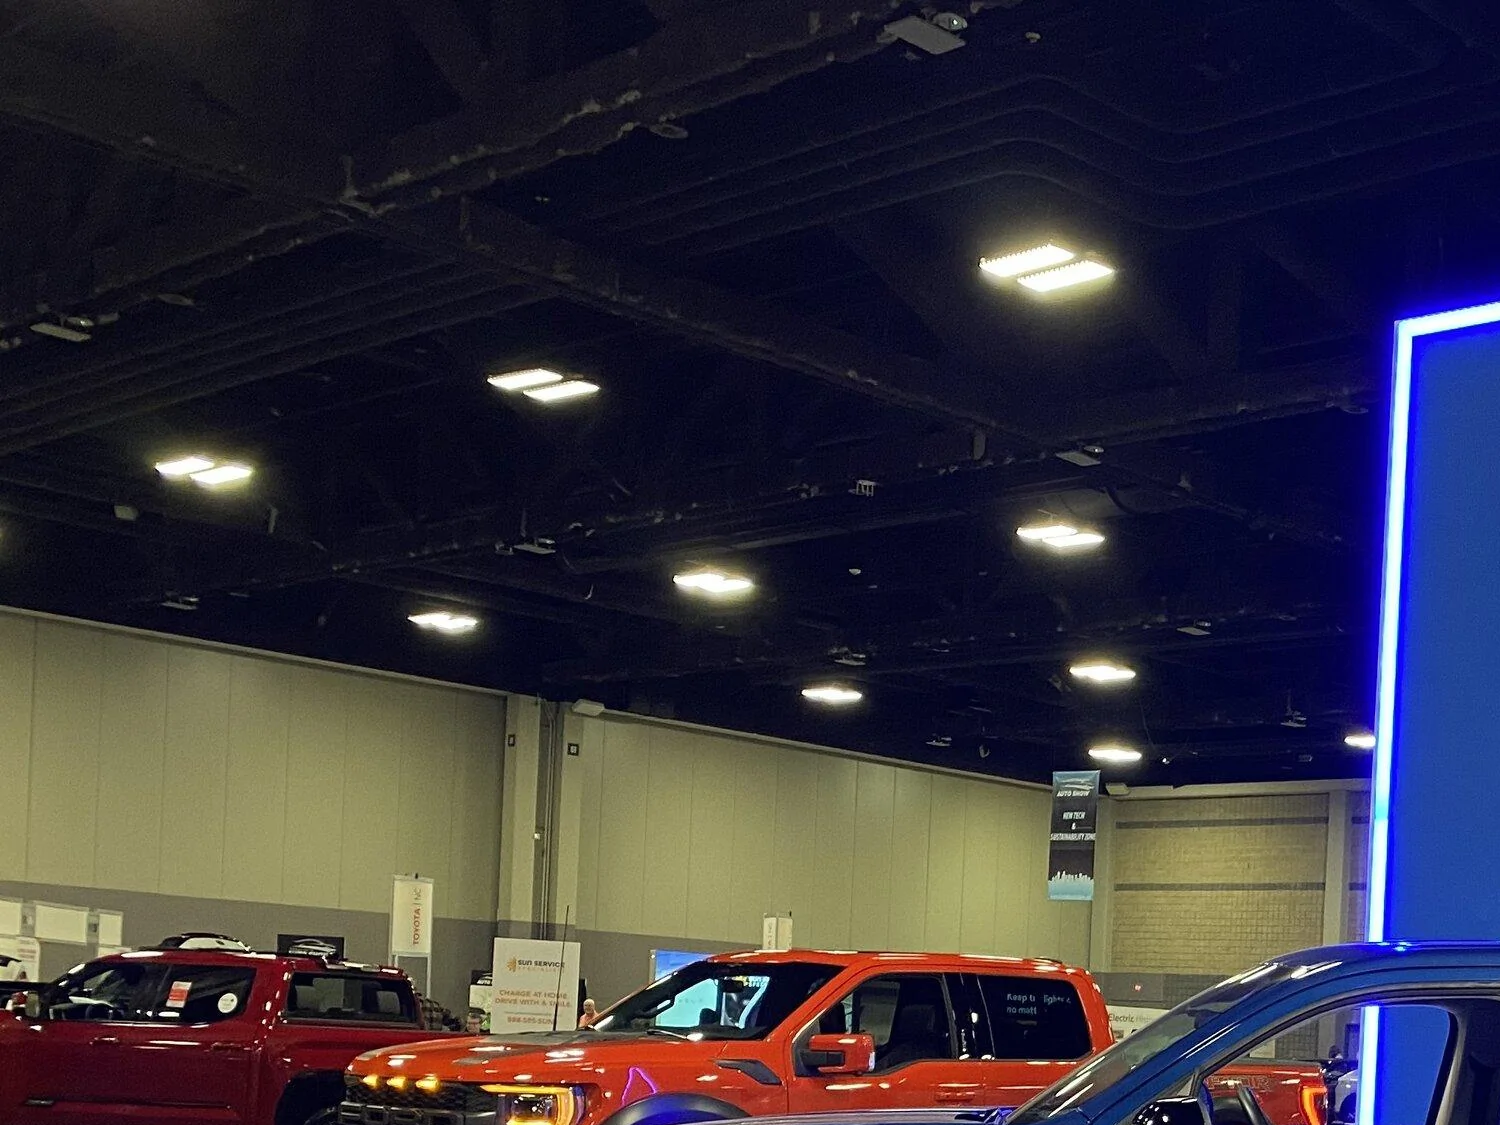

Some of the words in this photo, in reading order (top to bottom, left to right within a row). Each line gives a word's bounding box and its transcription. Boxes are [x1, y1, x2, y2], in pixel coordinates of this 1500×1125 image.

[1073, 811, 1085, 819] TECH
[413, 908, 421, 945] TOYOTA
[499, 989, 531, 997] CHARGE
